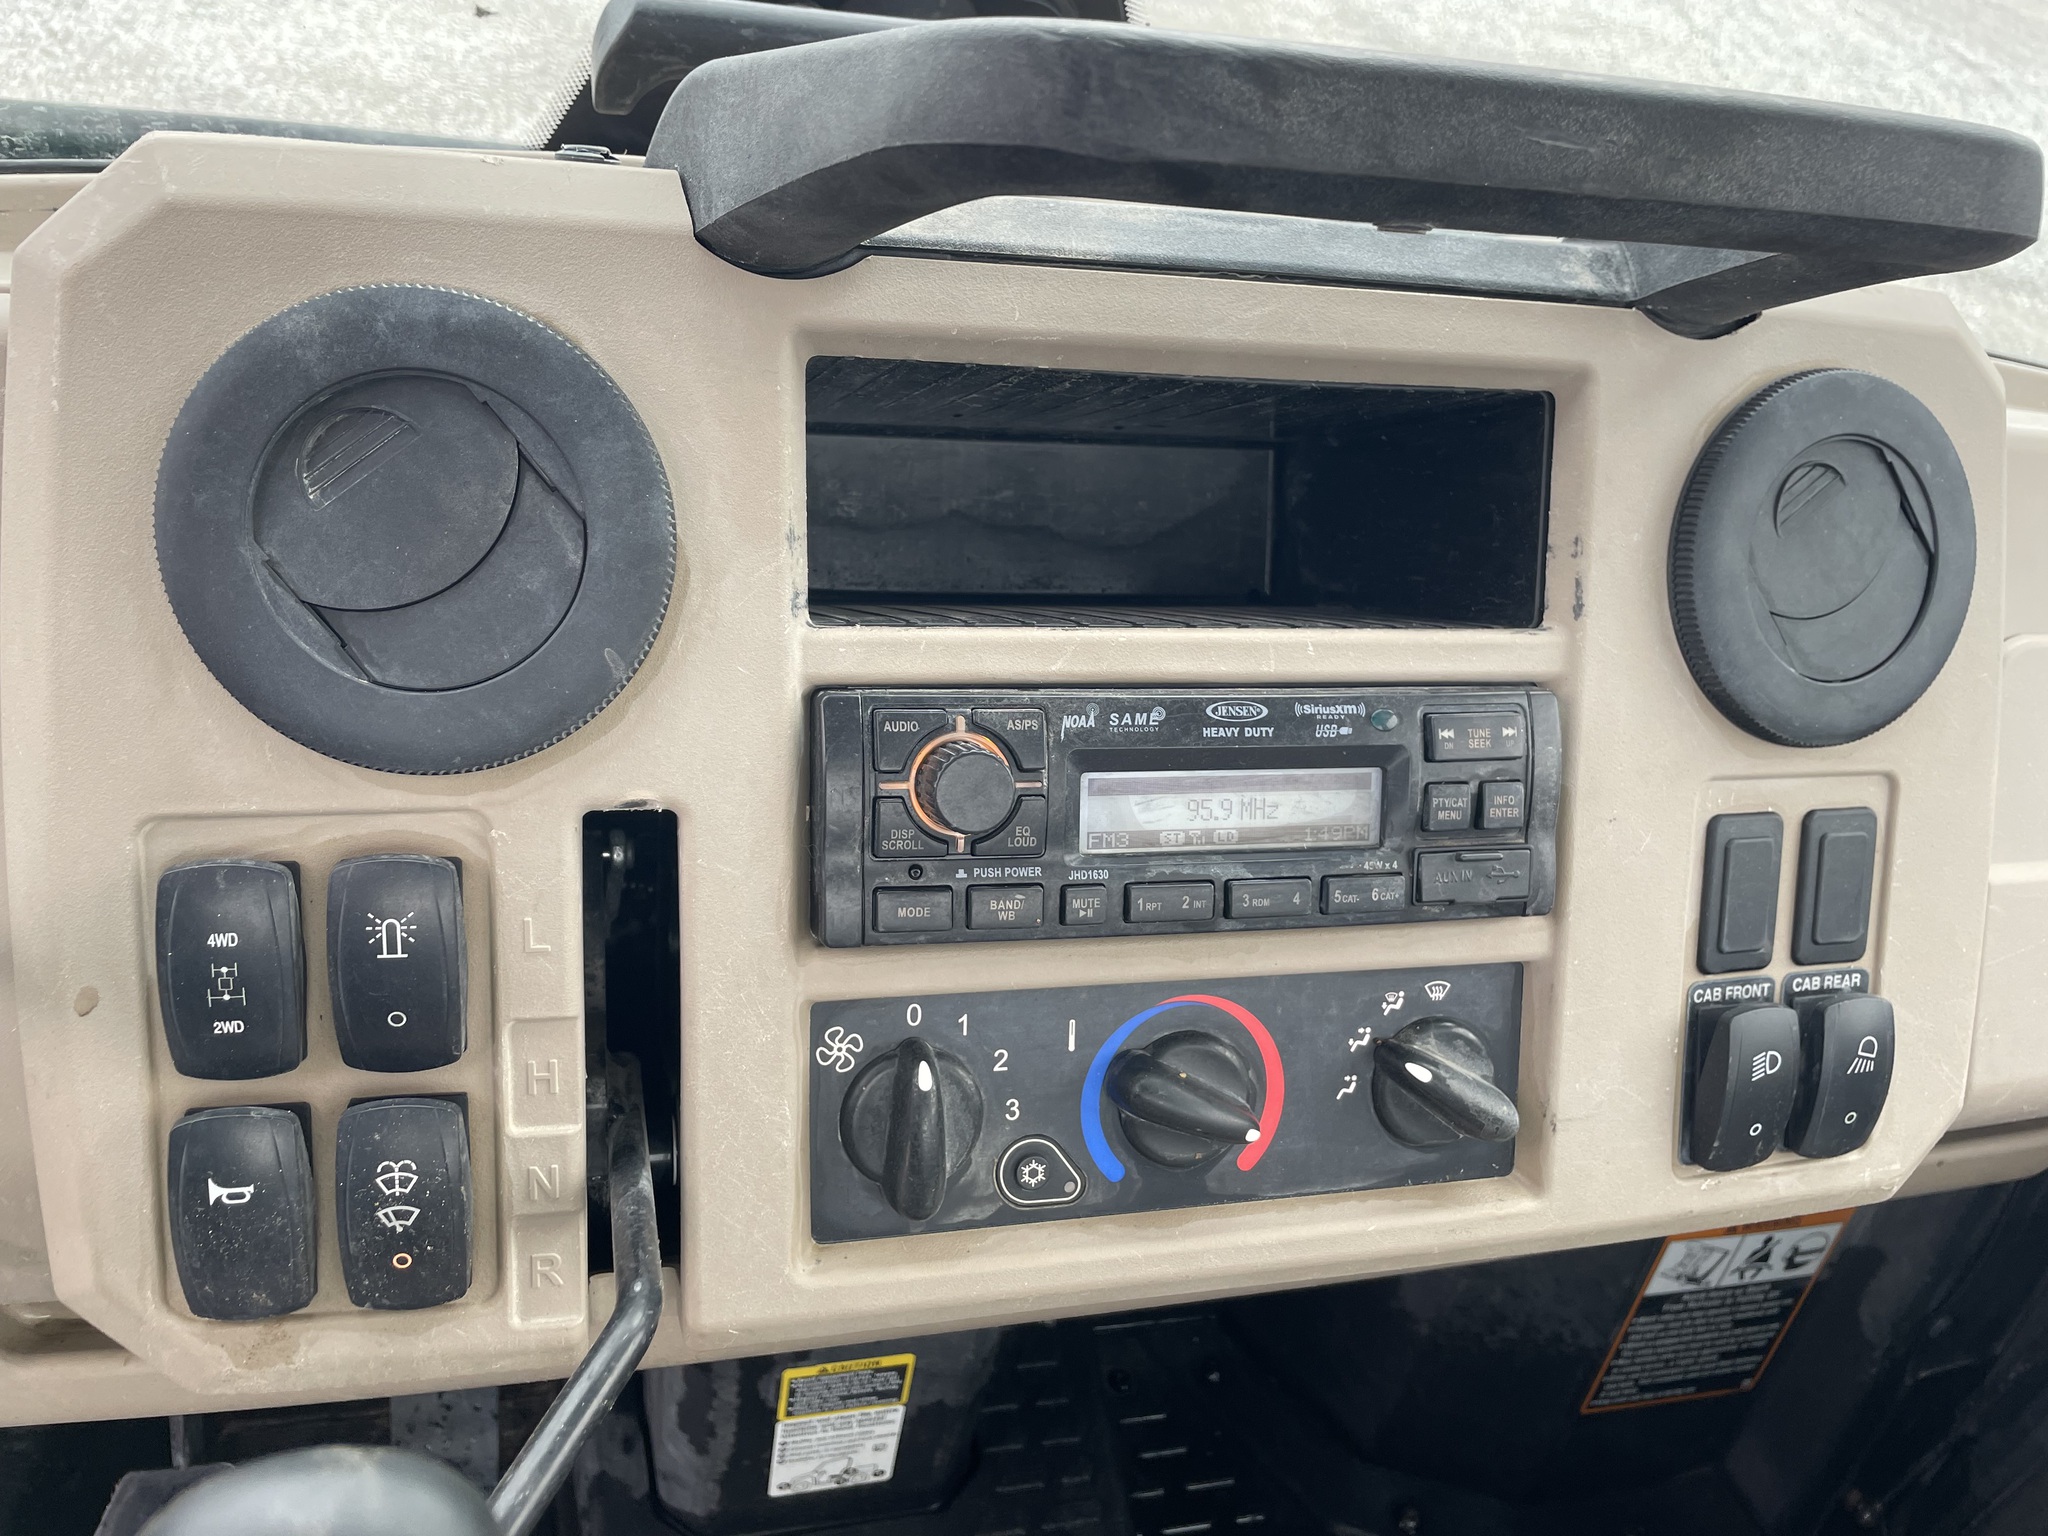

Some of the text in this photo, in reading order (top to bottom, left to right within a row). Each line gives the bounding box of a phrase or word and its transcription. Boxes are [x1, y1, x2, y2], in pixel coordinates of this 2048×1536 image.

[1215, 705, 1257, 717] JENSEN
[1006, 719, 1039, 731] AS/PS
[1061, 712, 1095, 738] NOAA
[1109, 713, 1160, 726] SAME
[883, 720, 919, 732] AUDIO
[1202, 727, 1275, 737] HEAVY DUTY
[1315, 724, 1338, 738] USB
[1467, 728, 1492, 738] TUNE
[1468, 738, 1492, 748] SEEK
[1432, 797, 1468, 808] PTY/CAT
[1493, 795, 1515, 805] INFO
[1187, 797, 1279, 822] 95.9 MHz
[1437, 810, 1462, 820] MENU
[1489, 807, 1519, 818] ENTER
[890, 829, 915, 839] DISP
[1015, 826, 1031, 837] EQ
[1303, 824, 1369, 843] 1:49PM
[1007, 836, 1038, 847] LOUD
[1088, 831, 1130, 848] FM3
[1162, 832, 1182, 844] ST
[881, 839, 924, 850] SCROLL
[1392, 860, 1398, 869] 4
[973, 867, 1042, 878] PUSH POWER
[1068, 870, 1109, 880] JHD1630
[1434, 870, 1473, 884] AUX IN
[1072, 898, 1101, 908] MUTE
[1182, 896, 1206, 909] 2 INT
[1242, 894, 1270, 907] 3 RDM
[1292, 892, 1300, 904] 4
[990, 900, 1025, 910] BAND/
[897, 907, 931, 917] MODE
[997, 910, 1016, 921] WB
[207, 932, 239, 948] 4WD
[523, 917, 551, 953] L
[1792, 973, 1862, 992] CAB REAR
[1693, 982, 1771, 1003] CAB FRONT
[906, 1003, 922, 1026] 0
[213, 1019, 245, 1034] 2WD
[958, 1013, 969, 1036] 1
[993, 1049, 1009, 1072] 2
[527, 1058, 560, 1096] H
[1004, 1099, 1020, 1121] 3
[529, 1164, 560, 1200] N
[531, 1252, 564, 1289] R
